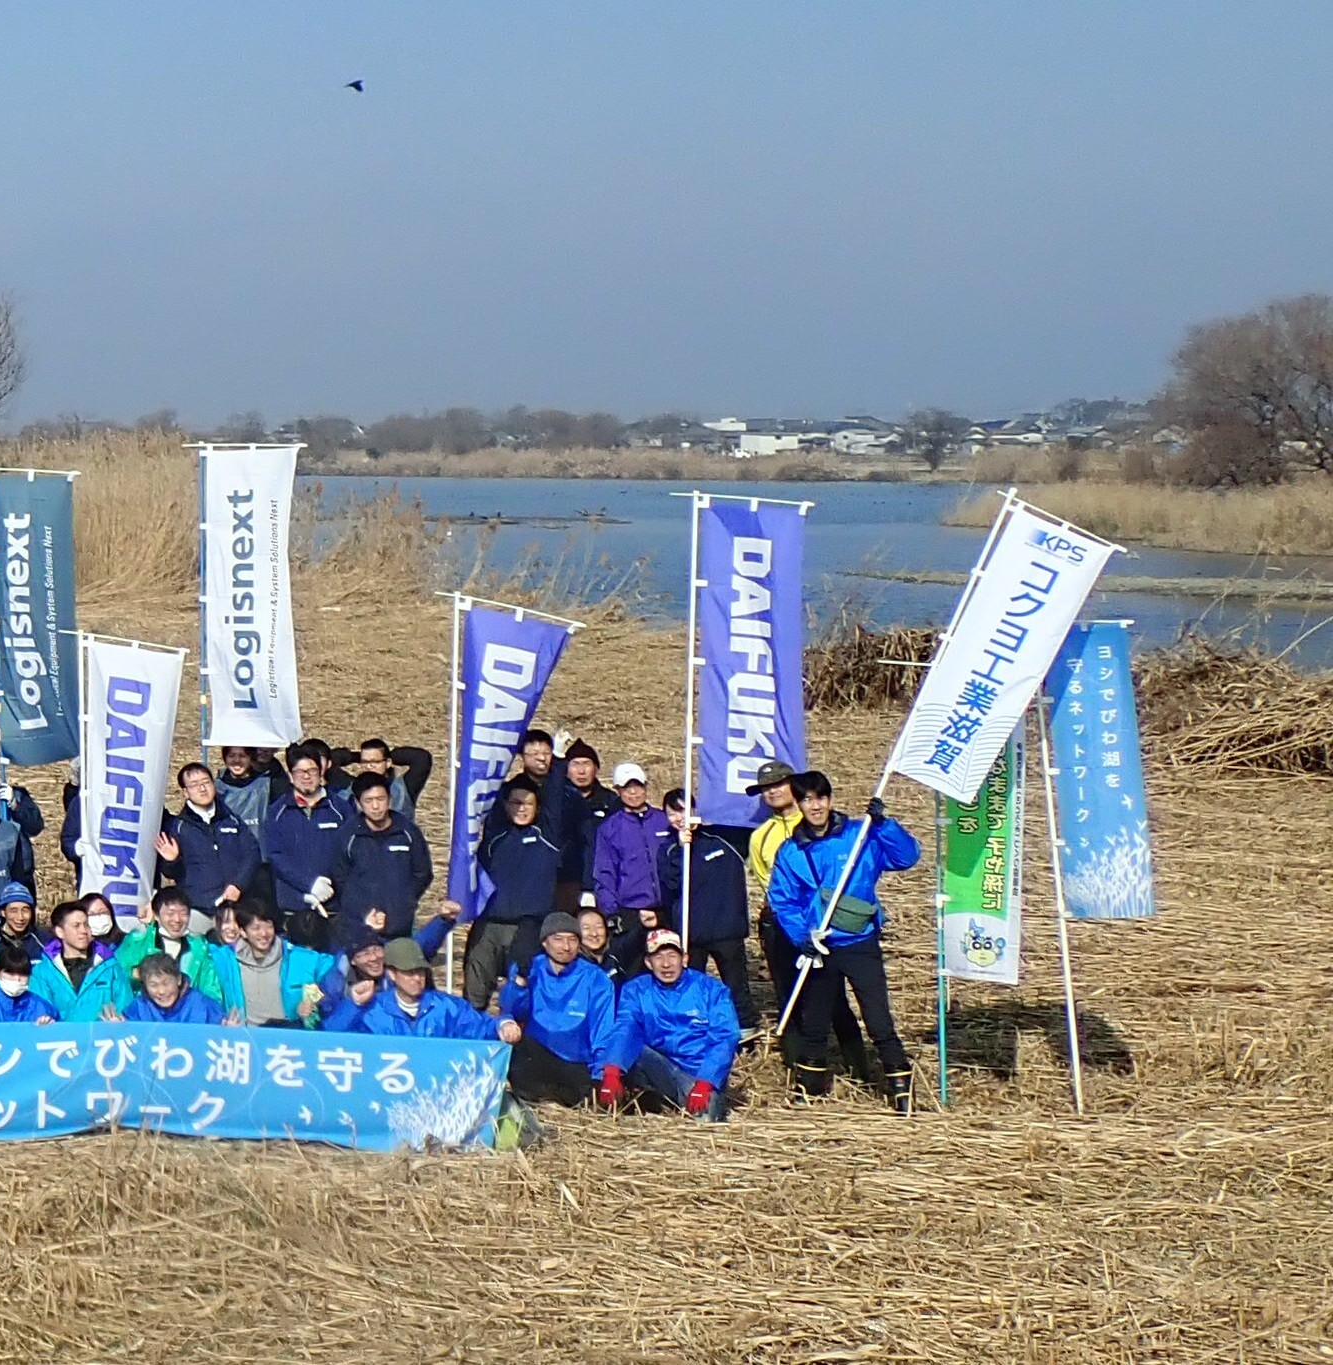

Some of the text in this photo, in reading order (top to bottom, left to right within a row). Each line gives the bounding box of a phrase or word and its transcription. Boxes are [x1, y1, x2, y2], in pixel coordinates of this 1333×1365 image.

[270, 499, 279, 520] Next
[44, 525, 53, 547] Next
[270, 522, 279, 564] Solutions
[1036, 530, 1088, 562] KPS
[44, 547, 54, 589] Solutions
[270, 566, 279, 597] System
[46, 590, 57, 620] System
[225, 488, 261, 710] Logisnext
[3, 512, 48, 730] Logisnext
[49, 632, 60, 675] Equipment
[726, 536, 776, 795] DAIFUKU
[923, 560, 1060, 775] コクヨ工業滋賀
[1098, 645, 1121, 788] ヨシでびわ湖を
[1066, 658, 1089, 824] 守るネットワーク
[99, 675, 152, 918] DAIFUKU
